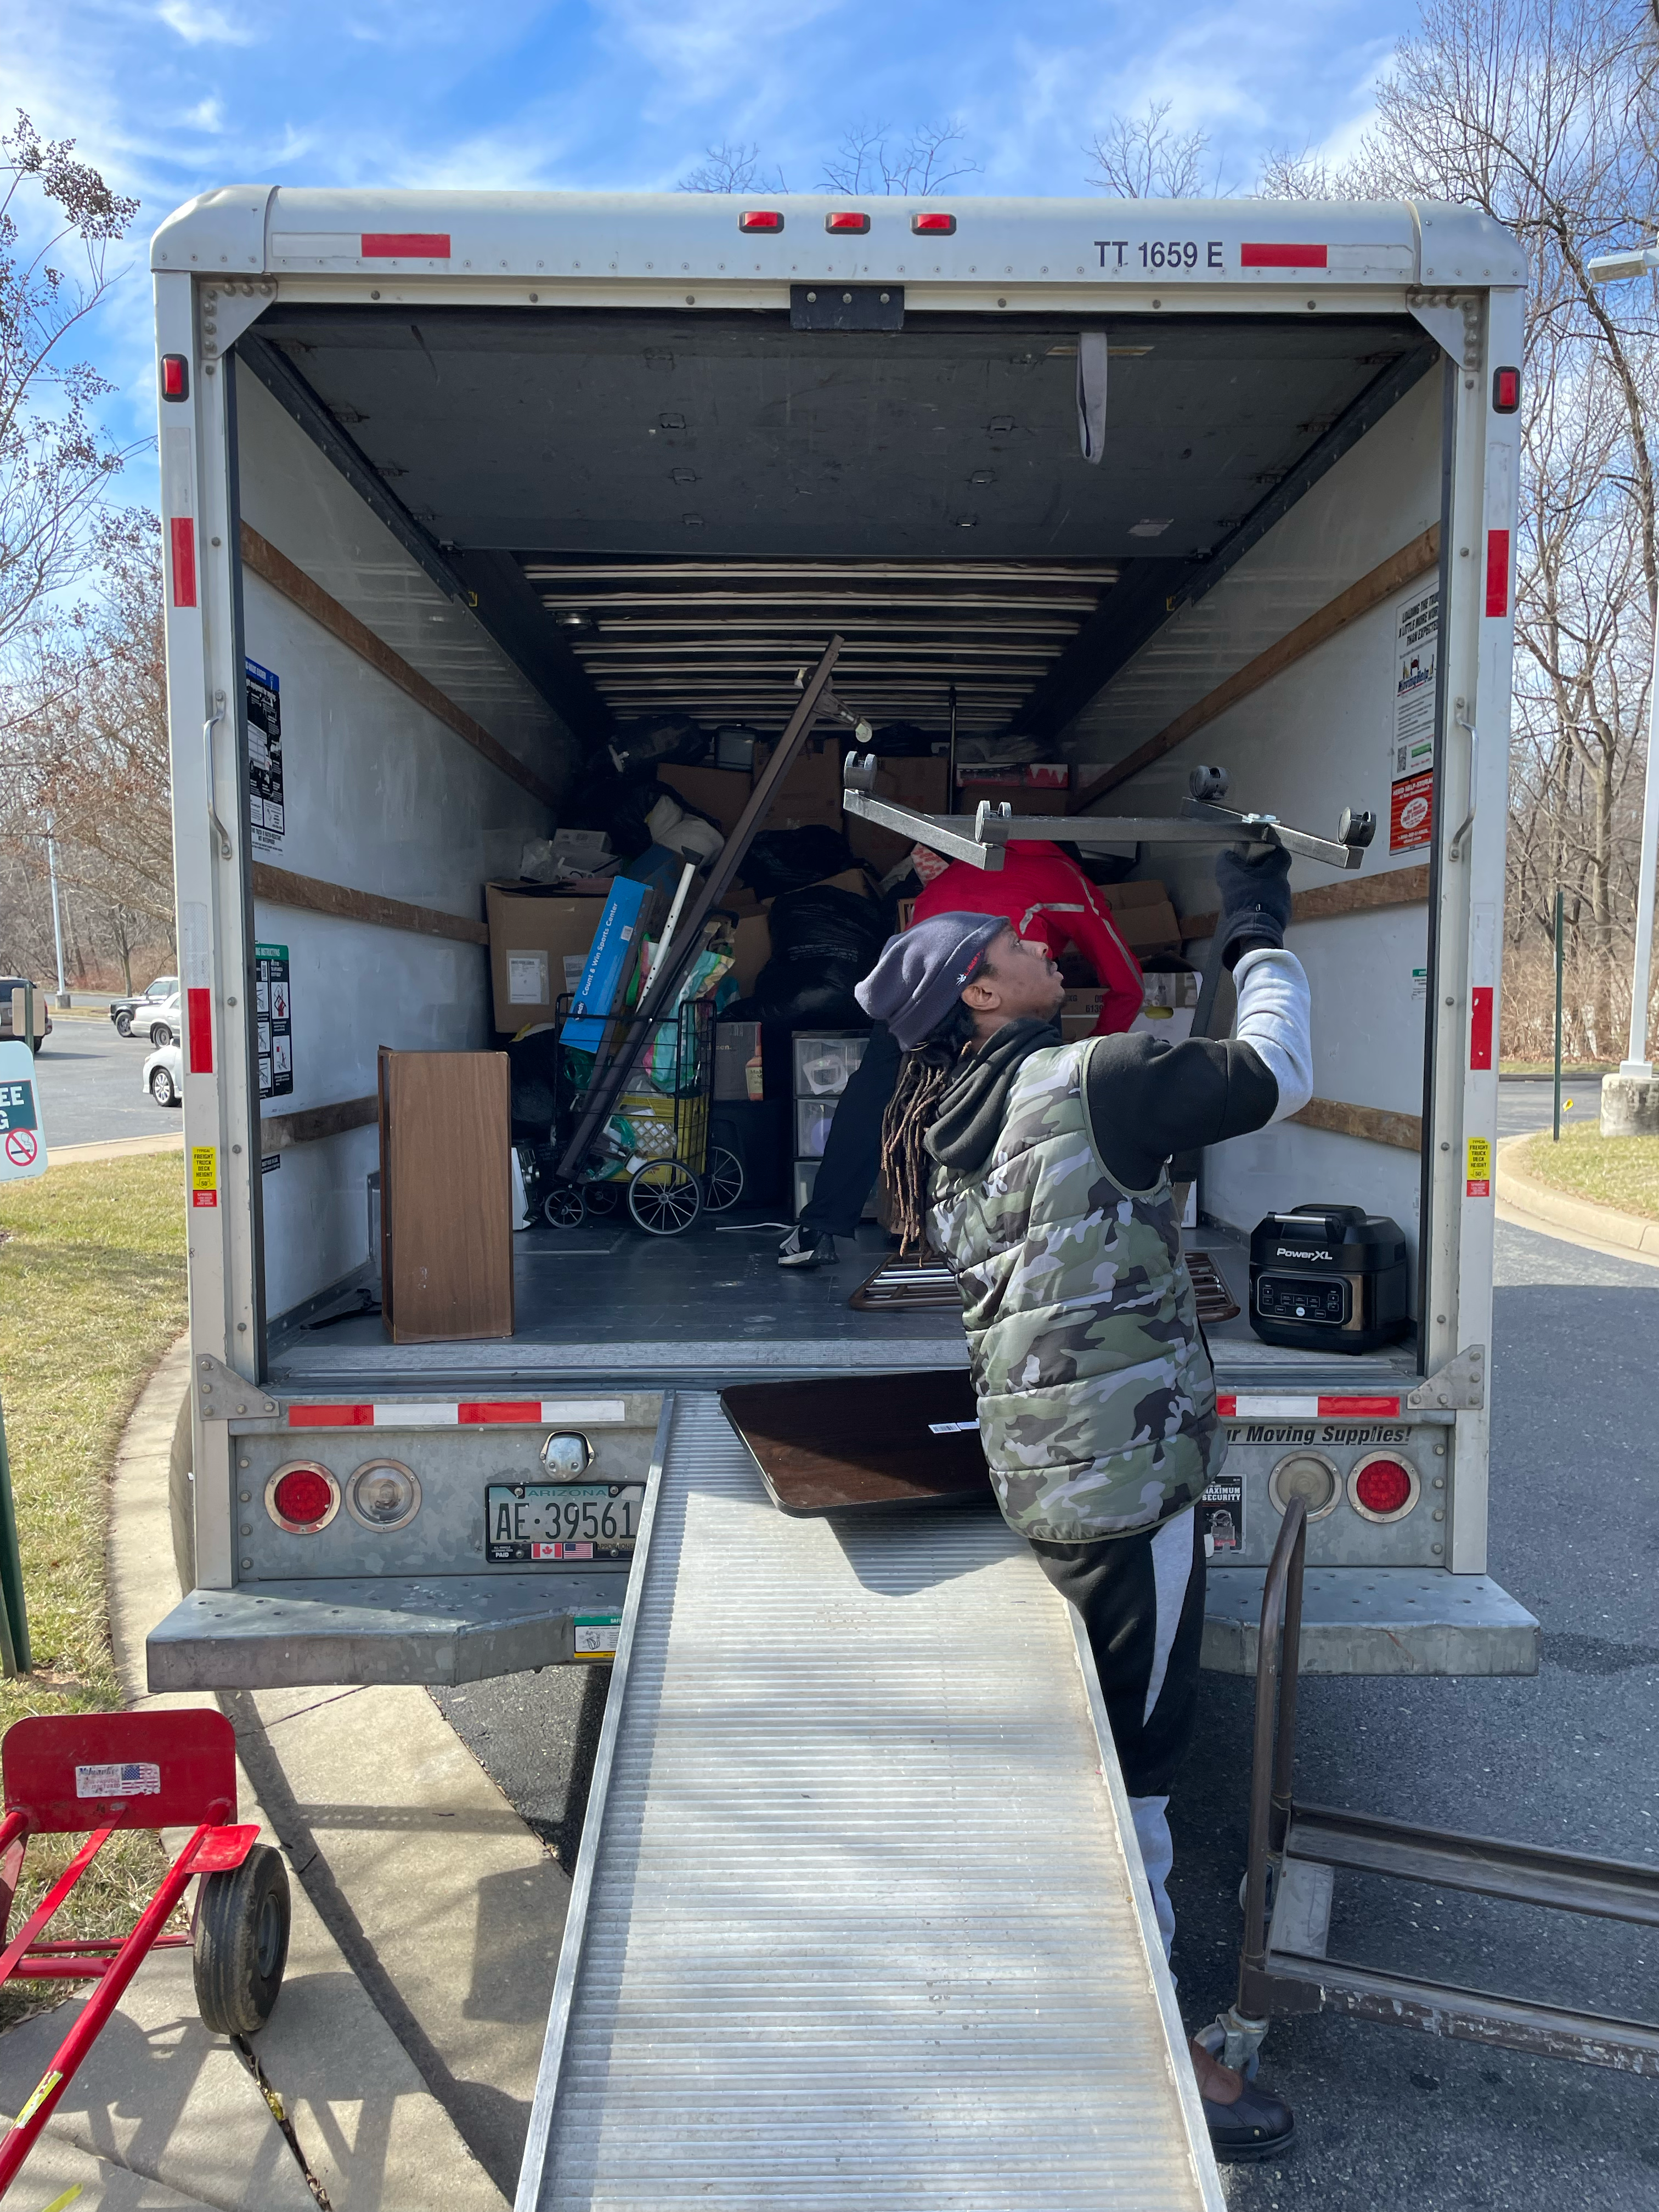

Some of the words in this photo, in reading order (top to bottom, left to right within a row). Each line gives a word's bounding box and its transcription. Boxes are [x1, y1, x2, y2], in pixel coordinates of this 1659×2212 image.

[1094, 241, 1128, 267] TT
[1138, 241, 1198, 268] 1659
[1207, 241, 1223, 268] E
[582, 973, 594, 996] Count
[591, 952, 601, 967] Win
[597, 928, 610, 951] Sports
[606, 902, 618, 927] Center
[1277, 1248, 1333, 1261] PowerXL
[1246, 1426, 1316, 1446] Moving
[1322, 1426, 1412, 1446] Supplies!
[528, 1489, 607, 1497] ARIZONA
